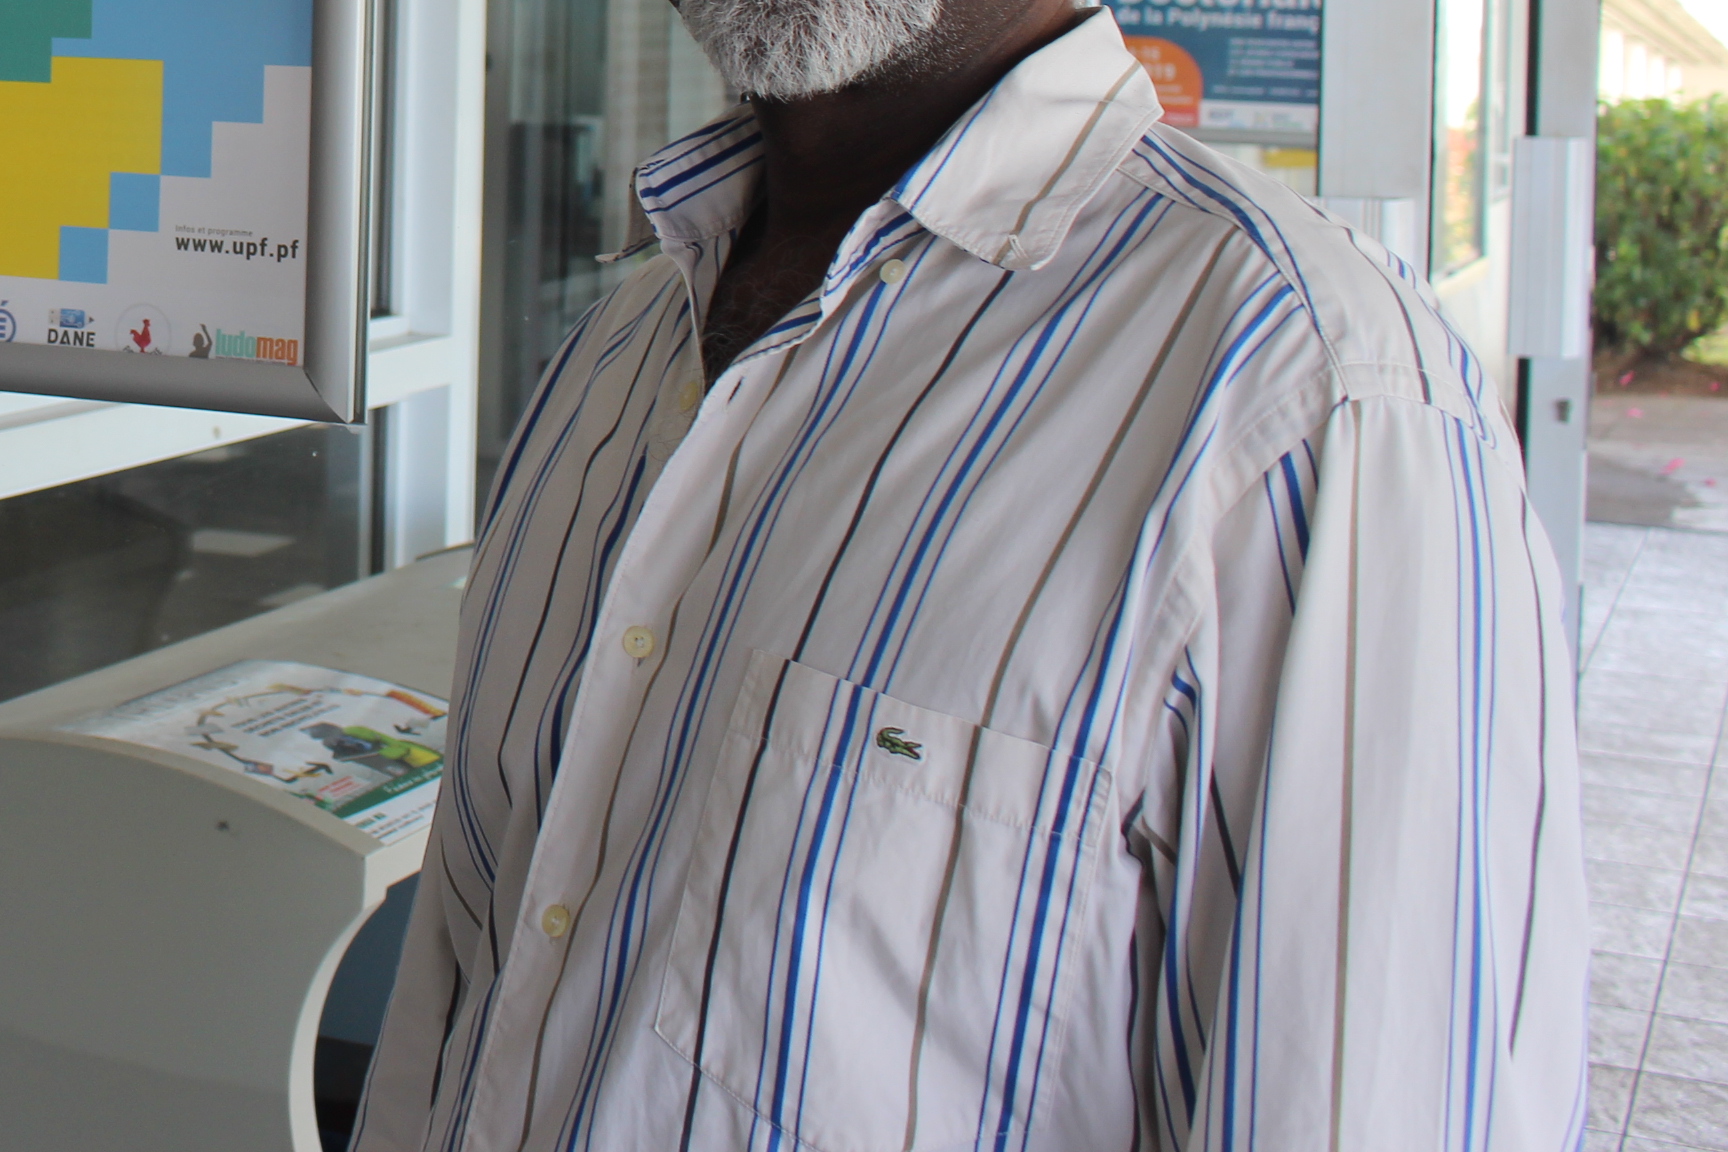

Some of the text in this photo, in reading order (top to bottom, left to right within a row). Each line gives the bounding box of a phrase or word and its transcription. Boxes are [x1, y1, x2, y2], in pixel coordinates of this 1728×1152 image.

[197, 226, 206, 234] et
[208, 228, 253, 237] programme
[175, 237, 300, 263] www.upf.pf
[47, 328, 96, 347] DANE
[215, 329, 299, 366] ludomag
